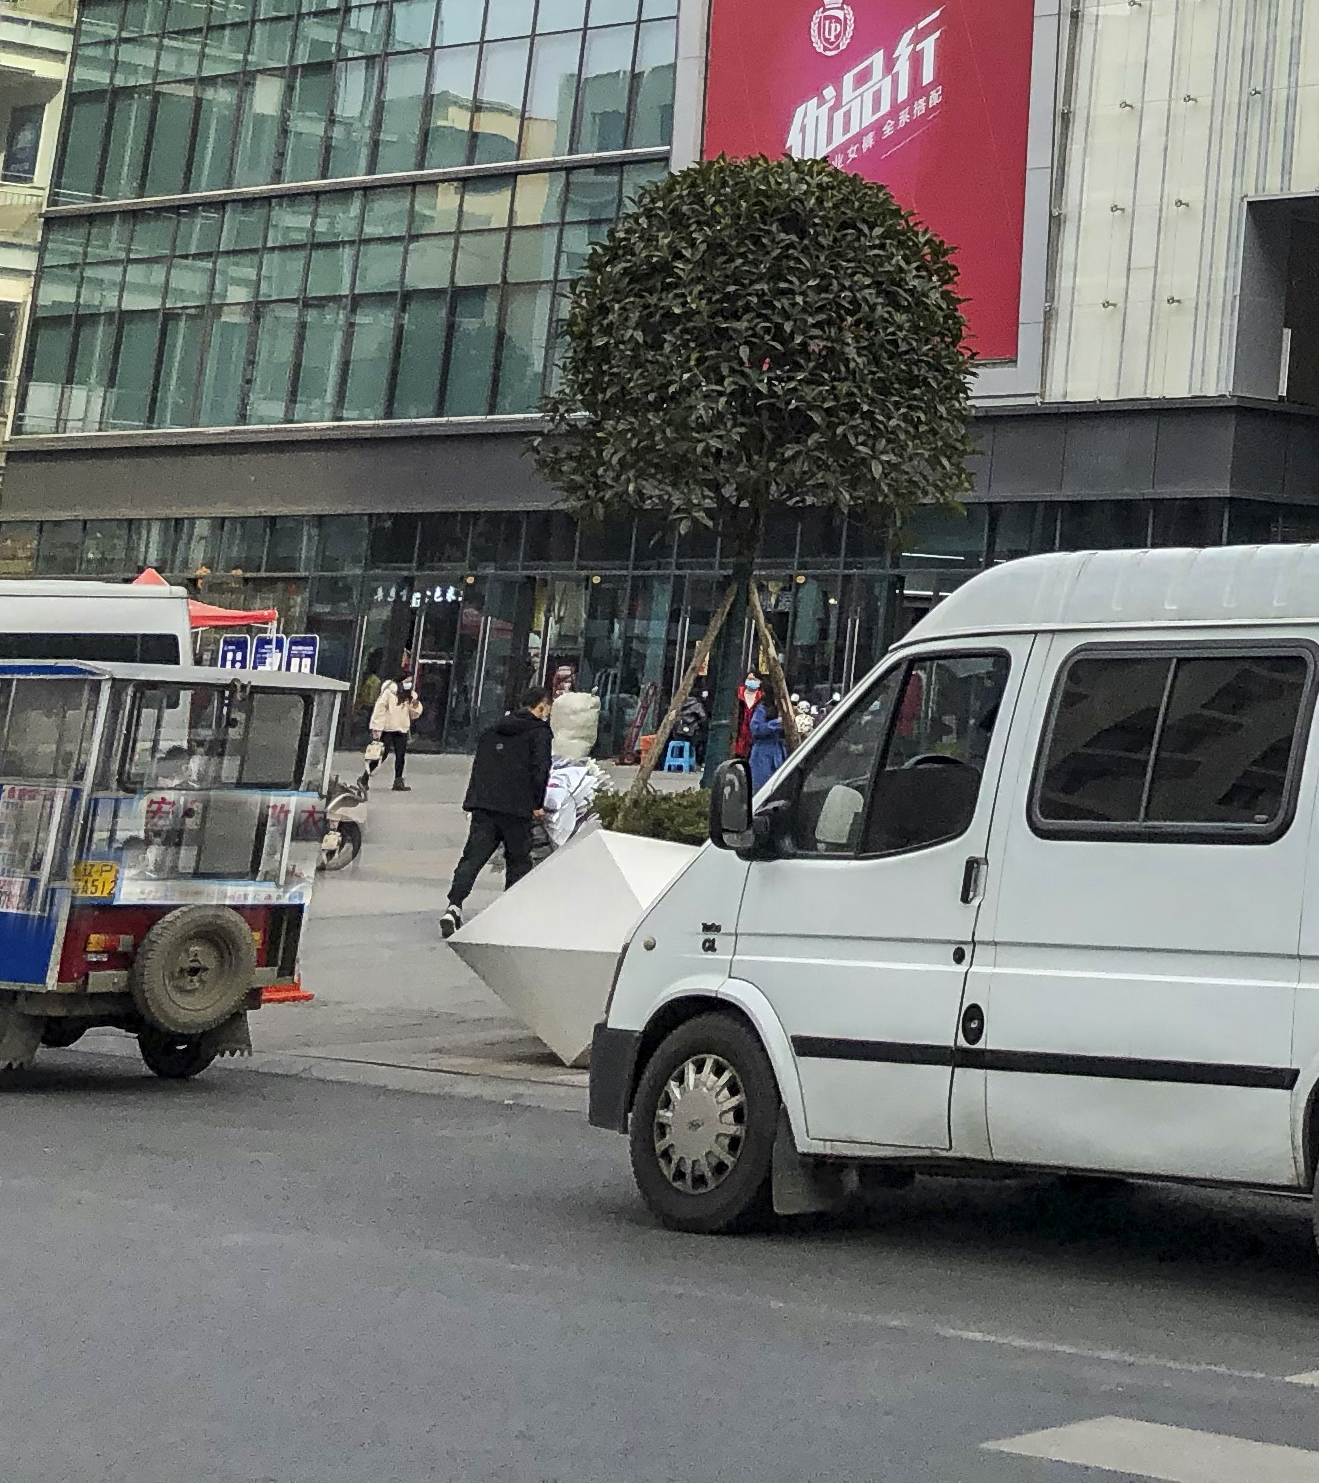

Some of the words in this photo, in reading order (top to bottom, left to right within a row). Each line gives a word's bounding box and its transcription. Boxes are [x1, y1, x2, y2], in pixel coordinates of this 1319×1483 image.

[785, 4, 946, 160] 优品行
[831, 130, 875, 168] 业女裤
[881, 85, 943, 140] 全系搭配
